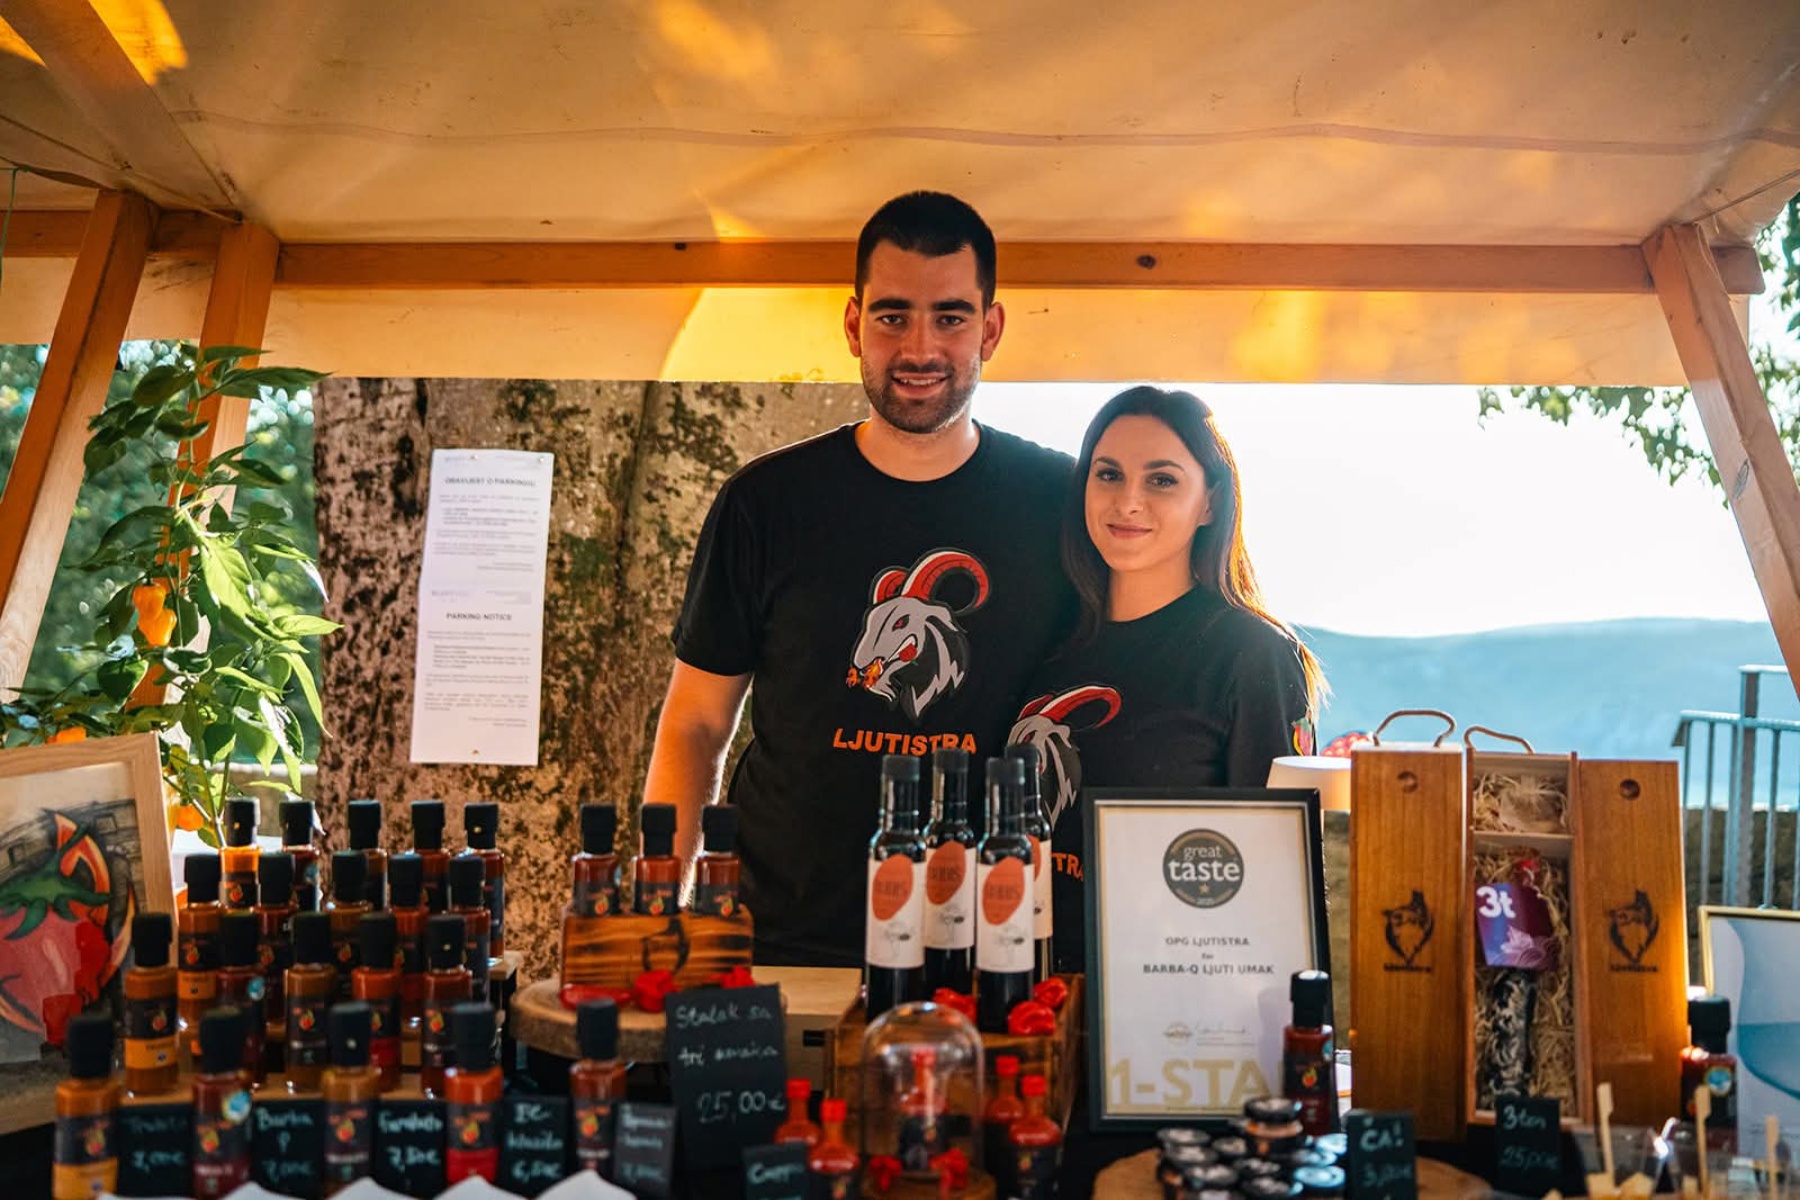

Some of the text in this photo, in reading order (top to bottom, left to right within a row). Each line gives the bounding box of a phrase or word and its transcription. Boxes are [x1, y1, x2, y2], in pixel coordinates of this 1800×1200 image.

[446, 612, 512, 621] PARKING NOTICE
[832, 728, 978, 757] LJUTISTRA
[1183, 845, 1223, 861] great
[1168, 859, 1241, 882] taste
[1476, 885, 1516, 919] 3t
[1165, 936, 1250, 947] OPG LJUTISTRA
[1201, 952, 1214, 960] for
[1143, 963, 1275, 976] BARBA-Q LJUTI UMAK
[747, 1005, 772, 1021] sa
[696, 1090, 787, 1124] 25,00€
